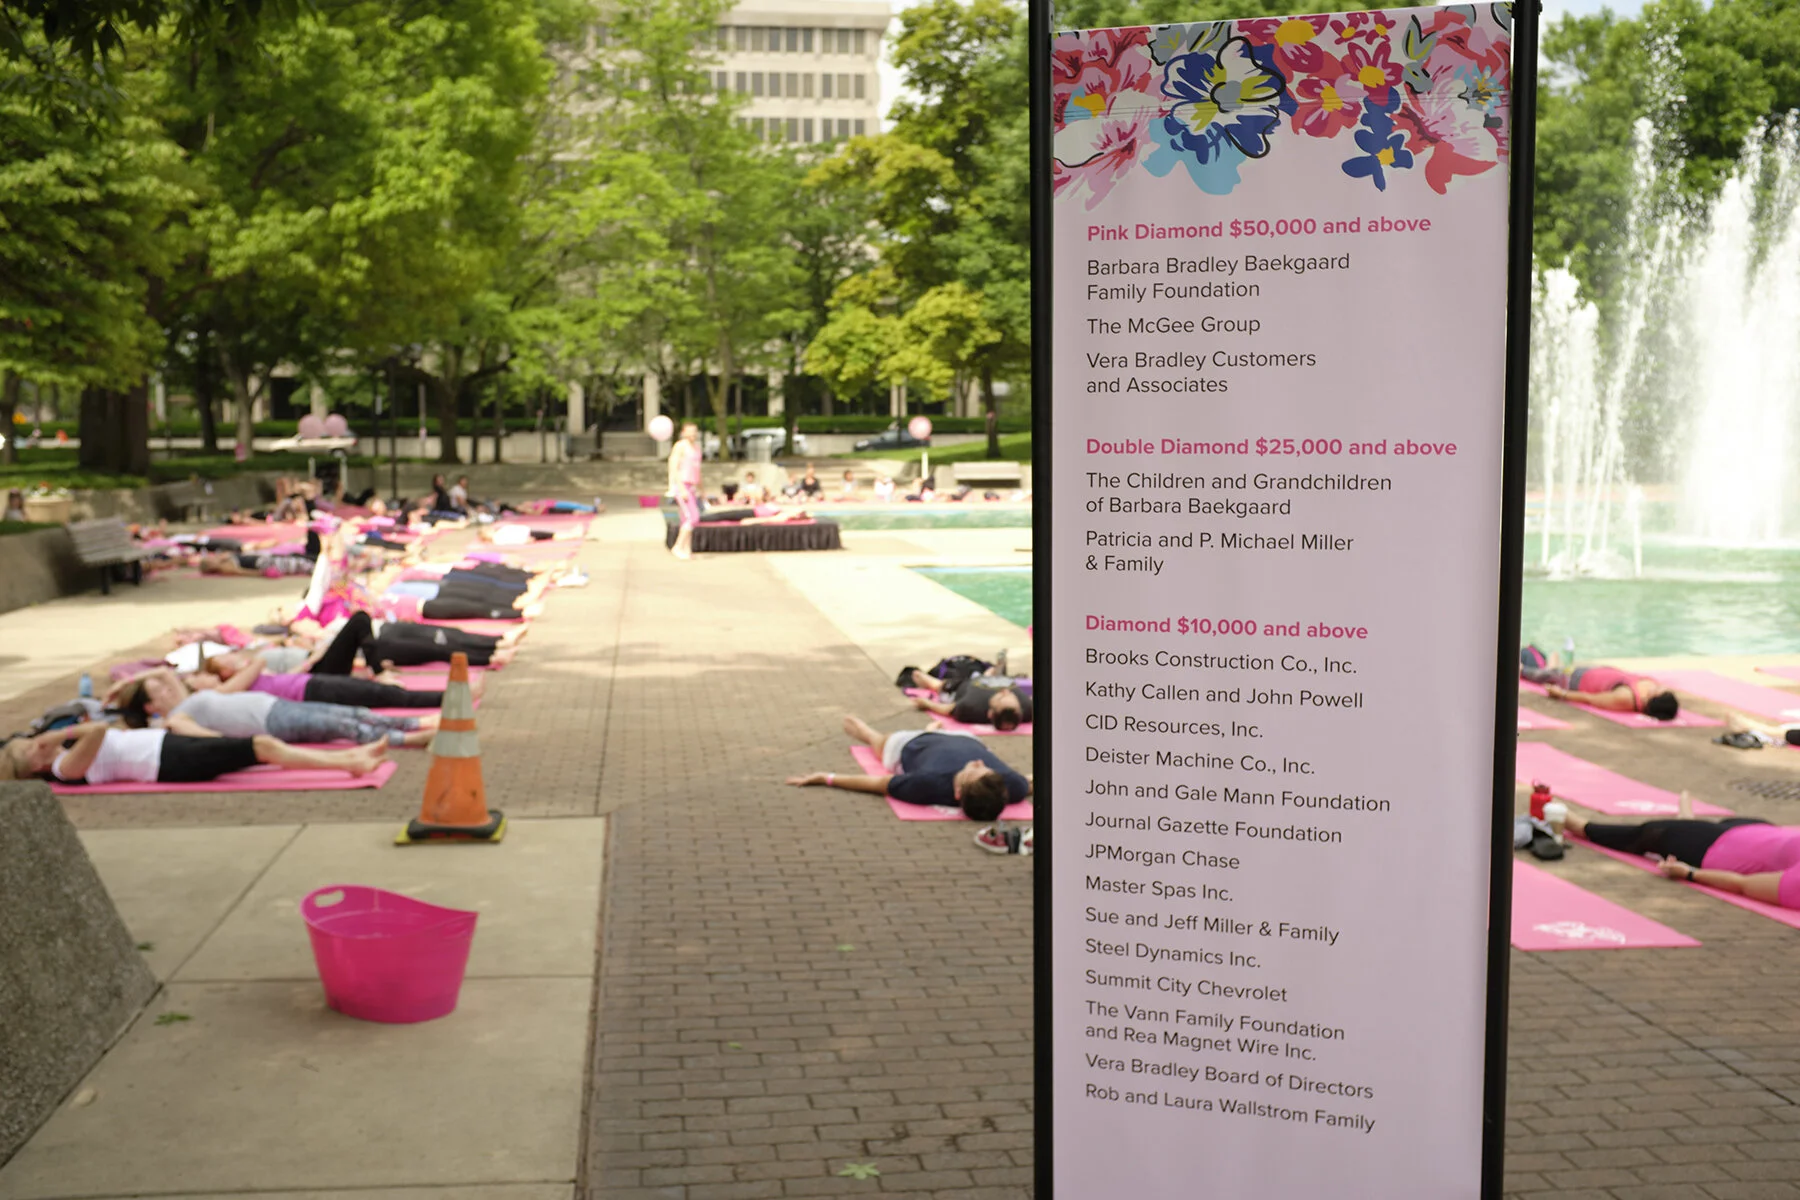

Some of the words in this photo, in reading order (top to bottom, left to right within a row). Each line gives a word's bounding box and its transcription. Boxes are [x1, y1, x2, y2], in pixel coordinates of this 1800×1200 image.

[1088, 225, 1128, 241] Pink
[1136, 221, 1222, 239] Diamond
[1230, 218, 1316, 238] $50,000
[1323, 217, 1360, 234] and
[1368, 216, 1431, 232] above
[1088, 259, 1159, 275] Barbara
[1167, 256, 1238, 276] Bradley
[1245, 253, 1349, 274] Baekgaard
[1088, 284, 1146, 303] Family
[1153, 281, 1259, 298] Foundation
[1087, 319, 1121, 334] The
[1129, 317, 1194, 333] McGee
[1201, 316, 1260, 335] Group
[1087, 353, 1127, 368] Vera
[1136, 352, 1206, 371] Bradley
[1213, 351, 1316, 367] Customers
[1087, 377, 1120, 393] and
[1127, 377, 1227, 392] Associates
[1087, 439, 1154, 454] Double
[1161, 438, 1248, 454] Diamond
[1256, 437, 1342, 457] $25,000
[1349, 439, 1386, 455] and
[1394, 439, 1457, 455] above
[1086, 472, 1120, 488] The
[1127, 473, 1204, 488] Children
[1212, 474, 1246, 489] and
[1254, 473, 1391, 490] Grandchildren
[1086, 497, 1104, 512] of
[1110, 497, 1181, 513] Barbara
[1189, 498, 1290, 518] Baekgaard
[1087, 531, 1151, 547] Patricia
[1159, 532, 1192, 547] and
[1200, 532, 1213, 548] P.
[1221, 533, 1294, 549] Michael
[1302, 534, 1354, 550] Miller
[1086, 555, 1098, 570] &
[1105, 555, 1164, 576] Family
[1086, 615, 1170, 632] Diamond
[1178, 616, 1257, 636] $10,000
[1264, 622, 1300, 637] and
[1307, 622, 1368, 639] above
[1086, 648, 1148, 666] Brooks
[1155, 651, 1273, 670] Construction
[1281, 655, 1317, 674] Co.,
[1325, 657, 1356, 673] Inc.
[1086, 681, 1136, 702] Kathy
[1142, 684, 1199, 700] Callen
[1206, 688, 1240, 703] and
[1246, 688, 1292, 705] John
[1300, 690, 1362, 708] Powell
[1086, 714, 1117, 730] CID
[1125, 716, 1224, 738] Resources,
[1232, 721, 1263, 737] Inc.
[1086, 747, 1150, 765] Deister
[1157, 751, 1233, 769] Machine
[1241, 755, 1276, 774] Co.,
[1284, 757, 1314, 774] Inc.
[1085, 780, 1128, 796] John
[1135, 784, 1168, 799] and
[1175, 785, 1217, 801] Gale
[1224, 788, 1274, 805] Mann
[1282, 791, 1390, 811] Foundation
[1085, 812, 1150, 830] Journal
[1158, 817, 1228, 835] Gazette
[1236, 821, 1341, 843] Foundation
[1085, 844, 1175, 866] JPMorgan
[1182, 851, 1239, 869] Chase
[1086, 875, 1146, 894] Master
[1152, 881, 1196, 899] Spas
[1203, 884, 1232, 901] Inc.
[1086, 907, 1119, 924] Sue
[1125, 913, 1157, 927] and
[1164, 914, 1198, 930] Jeff
[1204, 917, 1253, 935] Miller
[1259, 921, 1271, 936] &
[1279, 923, 1339, 946] Family
[1086, 938, 1128, 956] Steel
[1136, 943, 1223, 964] Dynamics
[1230, 952, 1260, 968] Inc.
[1086, 970, 1151, 990] Summit
[1157, 977, 1192, 997] City
[1198, 980, 1287, 1002] Chevrolet
[1086, 1000, 1118, 1017] The
[1125, 1005, 1168, 1022] Vann
[1176, 1010, 1234, 1032] Family
[1240, 1016, 1344, 1040] Foundation
[1086, 1026, 1117, 1040] and
[1124, 1027, 1156, 1043] Rea
[1164, 1031, 1231, 1052] Magnet
[1237, 1038, 1279, 1055] Wire
[1286, 1043, 1315, 1060] Inc.
[1086, 1053, 1124, 1071] Vera
[1132, 1059, 1199, 1082] Bradley
[1206, 1066, 1258, 1084] Board
[1266, 1074, 1283, 1087] of
[1289, 1075, 1373, 1098] Directors
[1086, 1084, 1119, 1101] Rob
[1125, 1092, 1157, 1105] and
[1165, 1093, 1212, 1111] Laura
[1219, 1099, 1307, 1122] Wallstrom
[1315, 1110, 1375, 1133] Family
